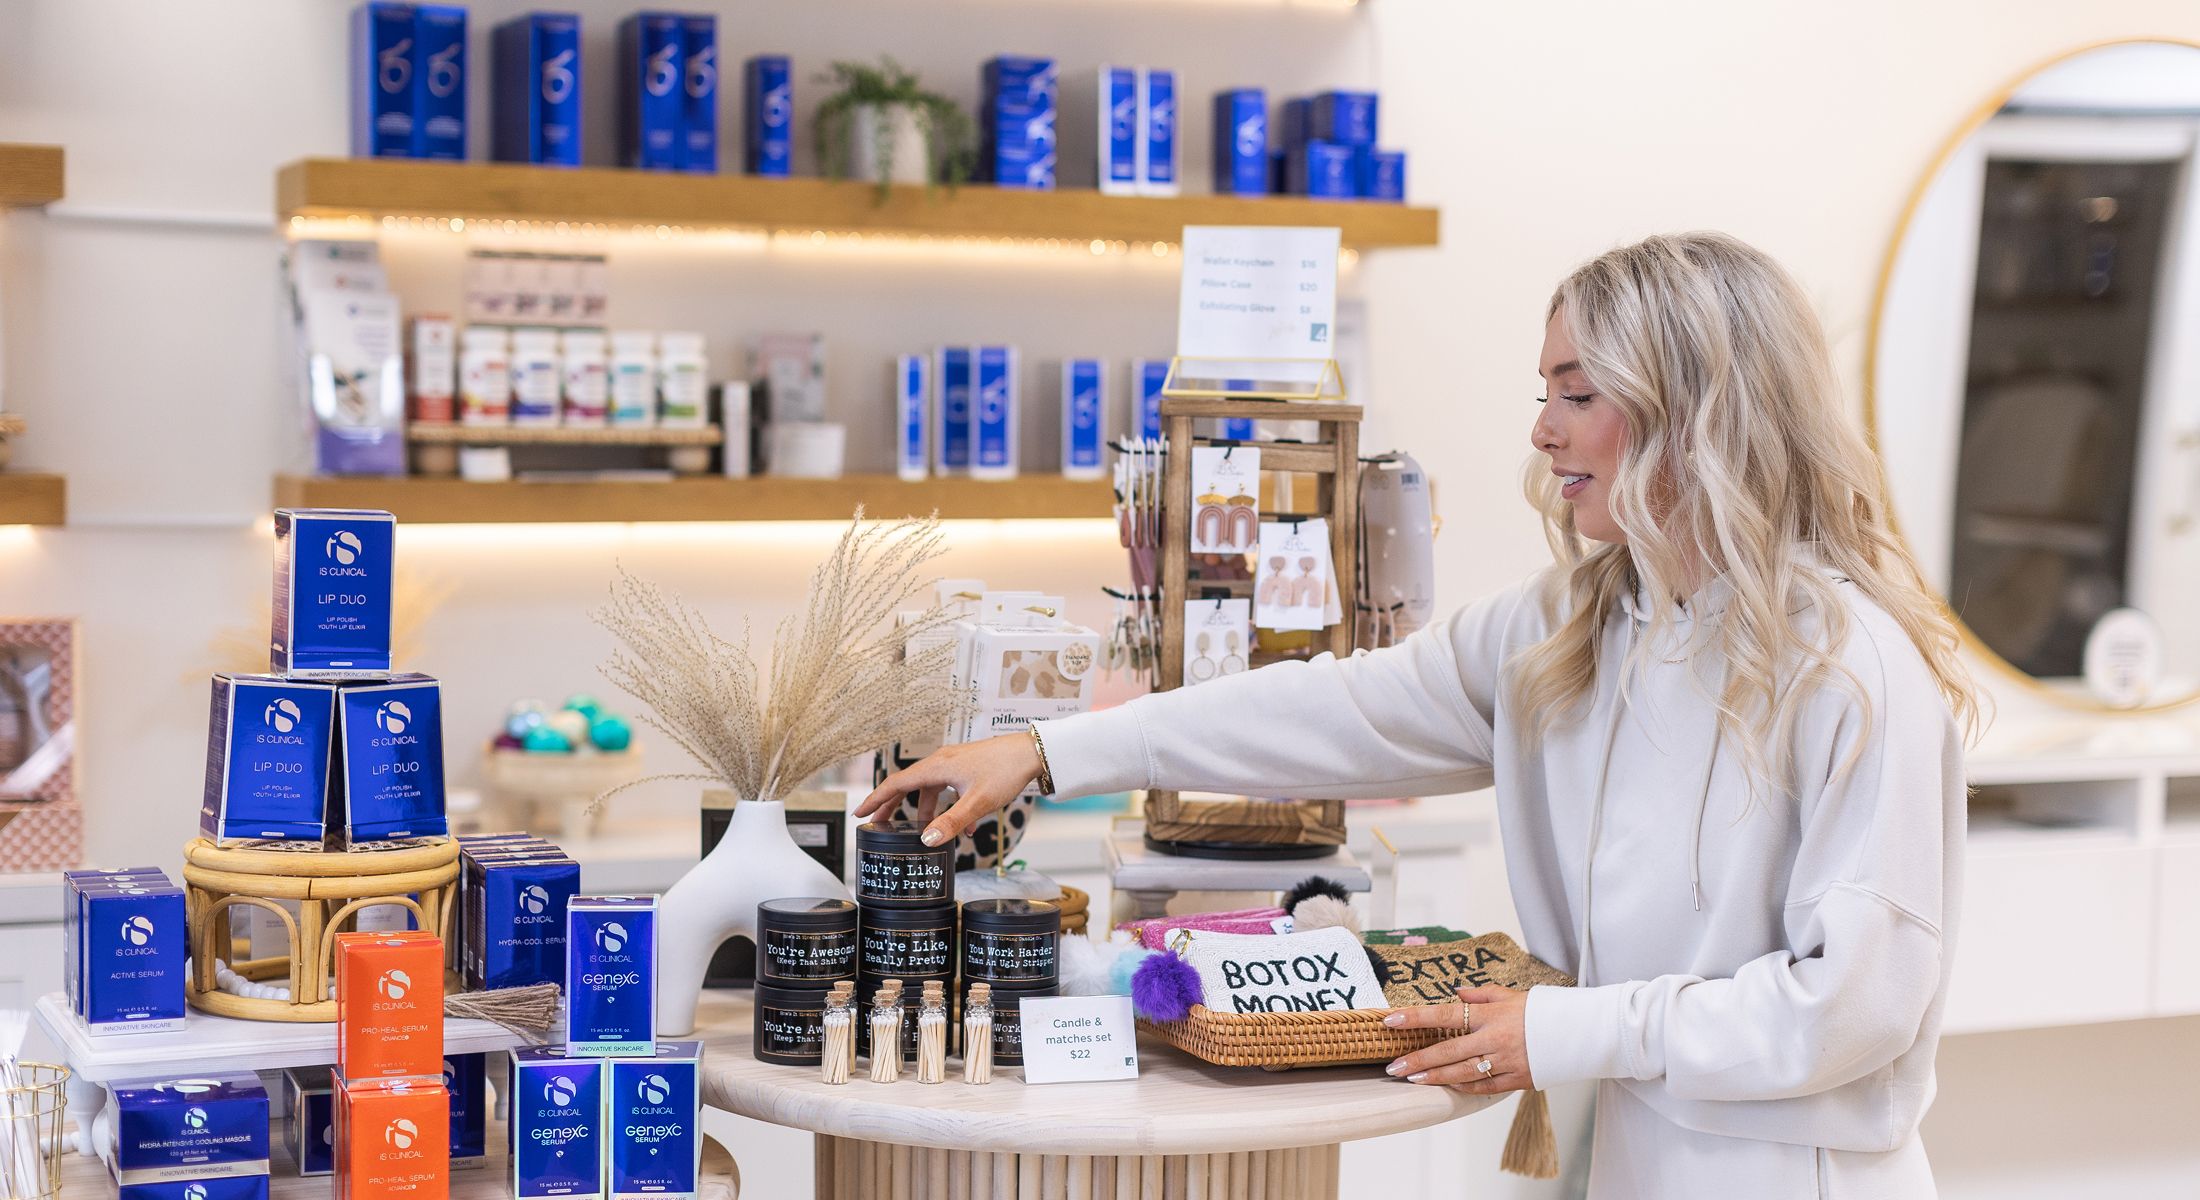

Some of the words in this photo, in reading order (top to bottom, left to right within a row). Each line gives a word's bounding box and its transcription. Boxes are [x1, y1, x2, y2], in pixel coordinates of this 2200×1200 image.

[1234, 258, 1274, 268] Keychain
[1201, 279, 1227, 288] Pillow
[1230, 279, 1252, 289] Case
[1200, 302, 1247, 313] Exfoliating
[1250, 304, 1275, 313] Glove
[329, 568, 367, 576] CLINICAL
[318, 595, 335, 604] LIP
[340, 595, 366, 605] DUO
[267, 735, 304, 745] CLINICAL
[381, 736, 418, 746] CLINICAL
[254, 762, 271, 772] LIP
[276, 763, 302, 773] DUO
[372, 764, 389, 775] LIP
[394, 762, 419, 773] DUO
[860, 861, 900, 875] You're
[907, 864, 943, 876] Like,
[861, 876, 898, 890] Really
[903, 879, 941, 889] Pretty
[522, 916, 554, 924] CLINICAL
[865, 937, 906, 952] You're
[913, 940, 948, 952] Like,
[125, 947, 158, 956] CLINICAL
[767, 944, 805, 957] You're
[810, 945, 855, 957] Awesome
[969, 944, 984, 955] You
[988, 947, 1014, 957] Work
[1019, 947, 1053, 957] Harder
[777, 956, 797, 966] (Keep
[839, 956, 848, 964] Up)
[865, 952, 904, 967] Really
[909, 955, 946, 965] Pretty
[968, 955, 984, 964] Than
[1000, 960, 1020, 968] Ugly
[1023, 958, 1053, 967] Stripper
[1222, 952, 1348, 989] BOTOX
[1385, 947, 1506, 984] EXTRA
[111, 972, 136, 980] ACTIVE
[138, 970, 164, 978] SERUM
[382, 1002, 416, 1010] CLINICAL
[103, 1023, 140, 1032] INNOVATIVE
[764, 1021, 802, 1034] You're
[1053, 1017, 1091, 1028] Candle
[1095, 1017, 1102, 1026] &
[994, 1024, 1021, 1033] Work
[774, 1034, 793, 1042] (Keep
[1007, 1036, 1022, 1044] Ugl
[1046, 1034, 1092, 1044] matches
[1096, 1033, 1111, 1042] set
[1070, 1050, 1090, 1059] $22
[547, 1109, 582, 1117] CLINICAL
[641, 1107, 675, 1115] CLINICAL
[139, 1139, 193, 1149] HYDRA-INTENSIVE
[225, 1135, 251, 1143] MASQUE
[389, 1151, 424, 1160] CLINICAL
[160, 1168, 198, 1177] INNOVATIVE
[200, 1166, 233, 1174] SKINCARE
[368, 1177, 406, 1185] PRO-HEAL
[409, 1174, 435, 1182] SERUM
